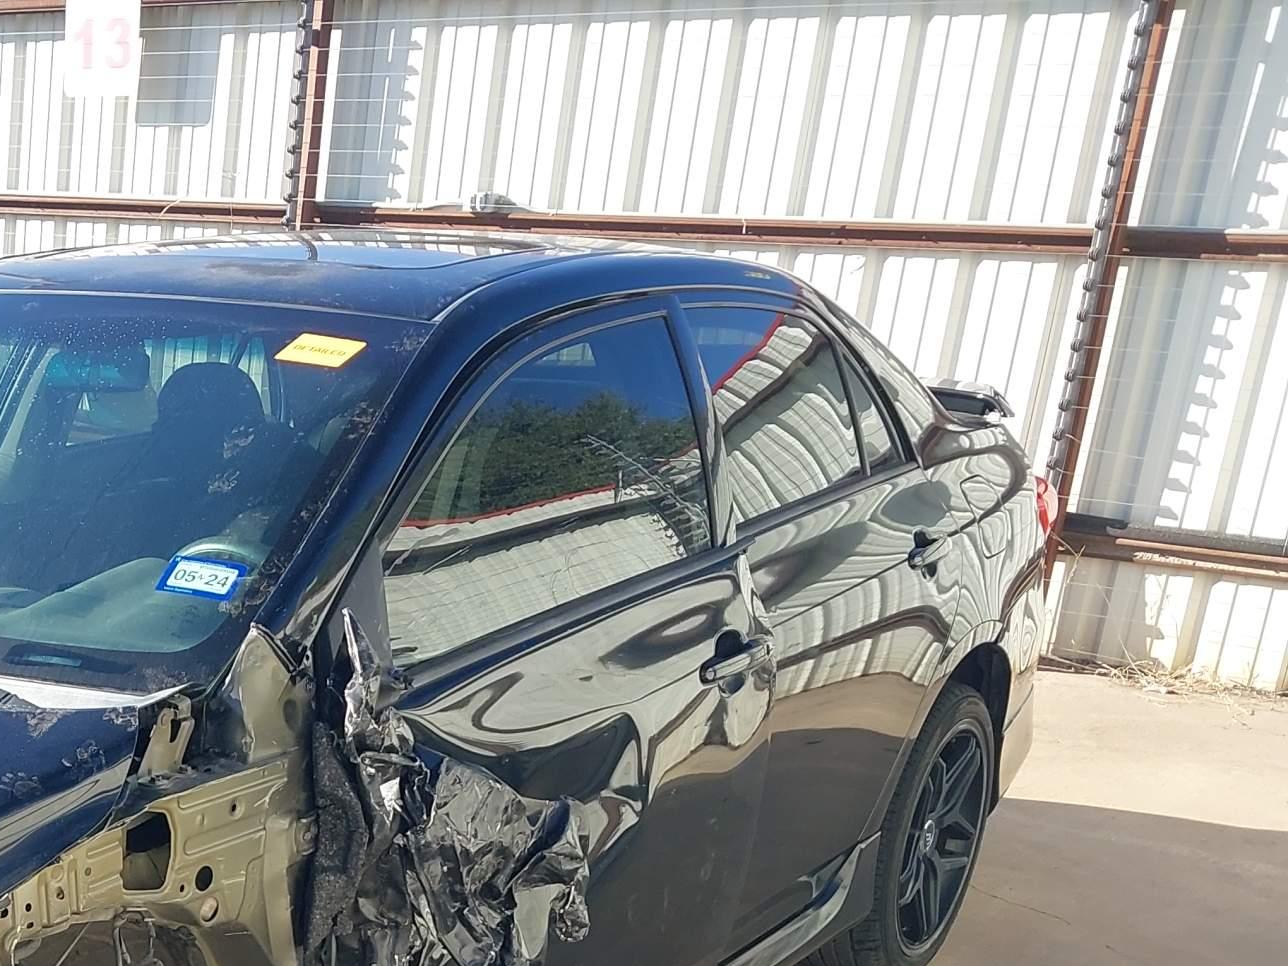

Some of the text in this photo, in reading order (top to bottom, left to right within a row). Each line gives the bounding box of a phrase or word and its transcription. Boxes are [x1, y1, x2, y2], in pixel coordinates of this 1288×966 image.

[73, 17, 132, 69] 13
[174, 568, 198, 582] 05
[204, 574, 230, 587] 24
